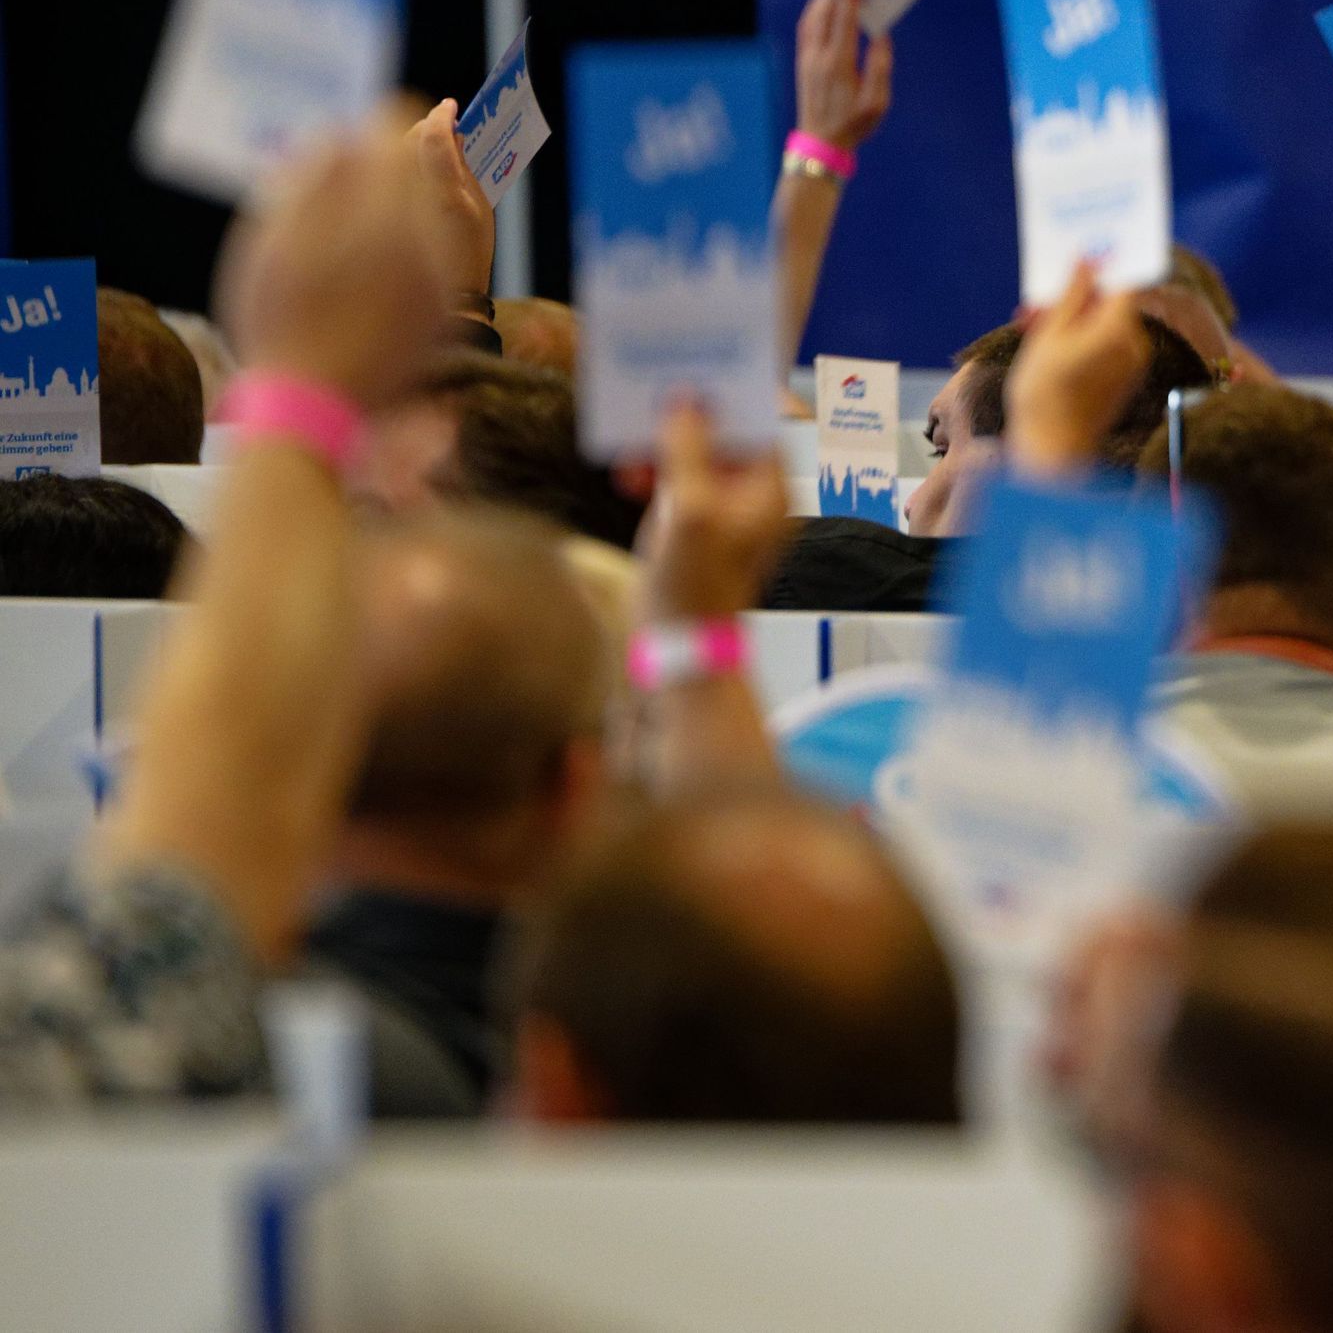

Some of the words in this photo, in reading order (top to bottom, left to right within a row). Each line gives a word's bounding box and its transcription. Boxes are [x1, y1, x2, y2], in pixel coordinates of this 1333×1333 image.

[0, 285, 62, 334] Ja!
[7, 432, 53, 443] Zukunft
[53, 432, 78, 441] eine
[35, 443, 74, 456] geben!
